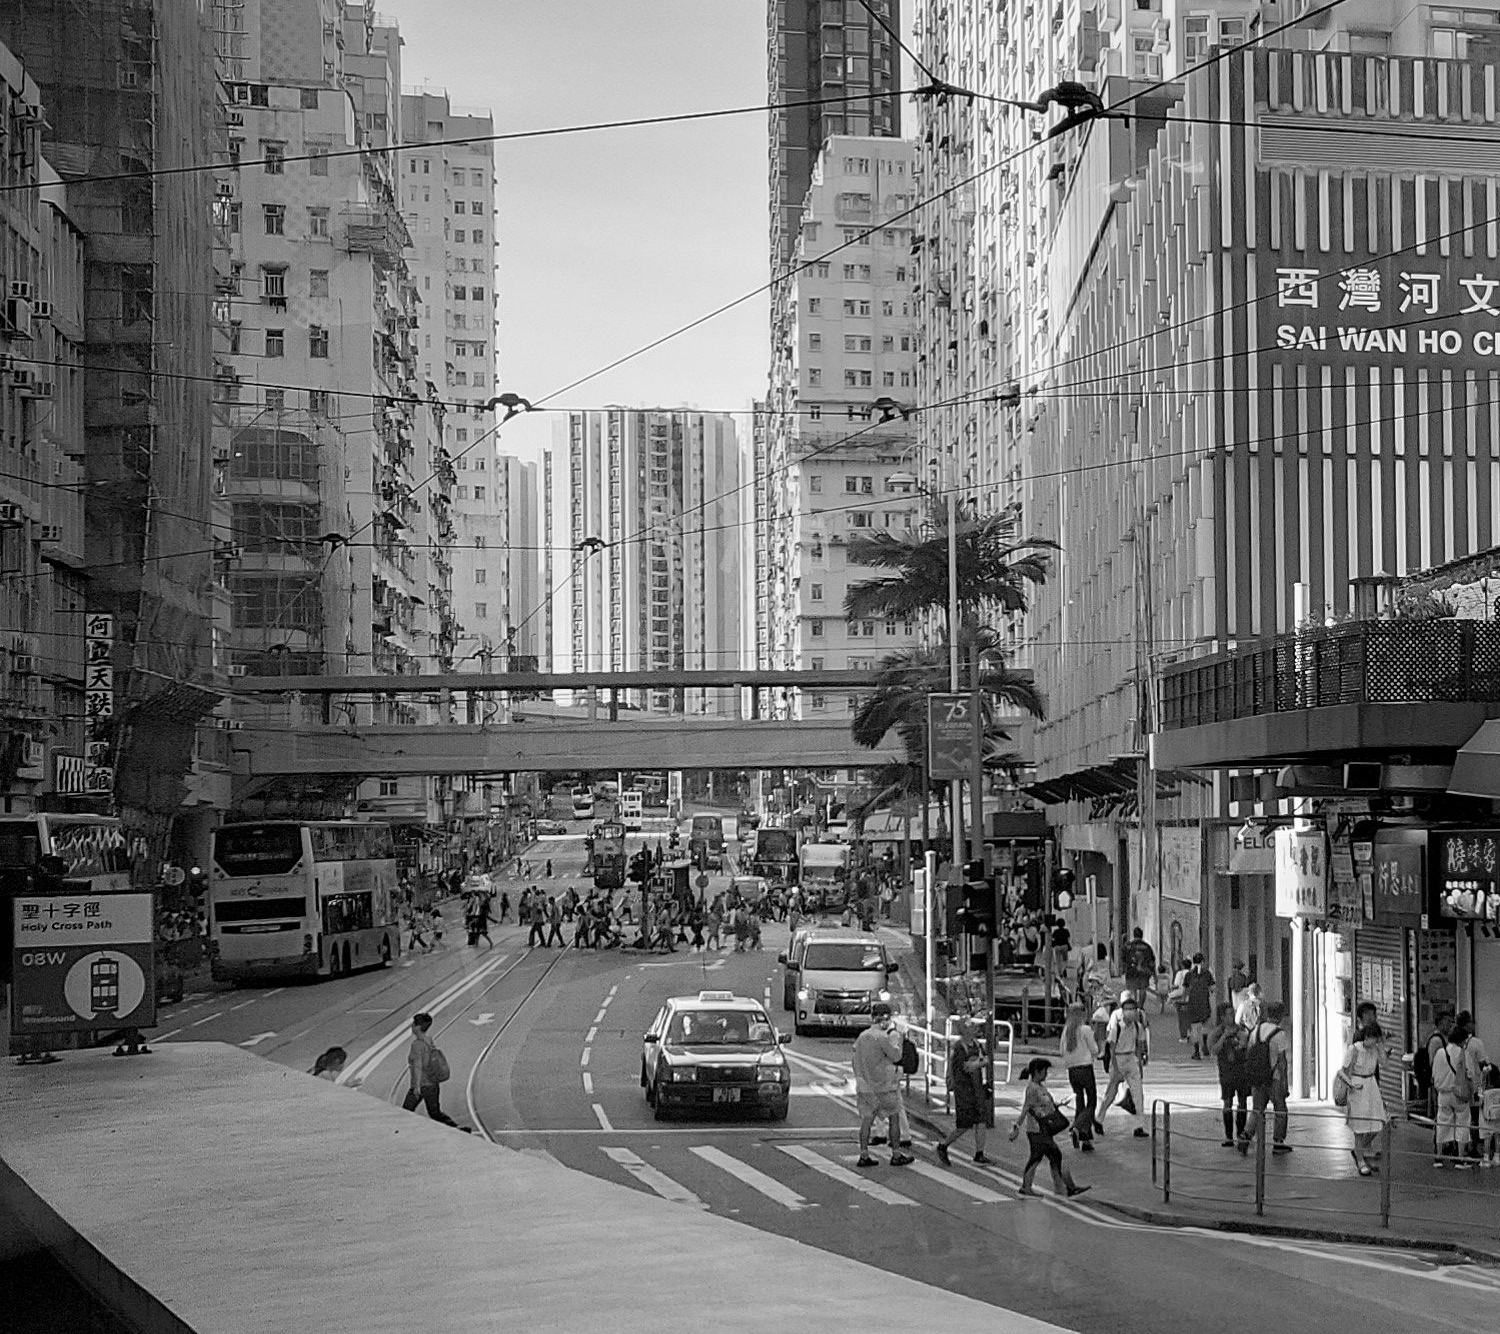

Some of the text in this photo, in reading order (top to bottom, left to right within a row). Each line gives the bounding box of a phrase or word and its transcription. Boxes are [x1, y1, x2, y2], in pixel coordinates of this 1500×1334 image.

[1276, 325, 1326, 351] SAI
[1337, 327, 1407, 353] WAN
[1418, 330, 1462, 355] HO
[21, 920, 112, 933] Holy Cross Path
[21, 951, 66, 967] 08W
